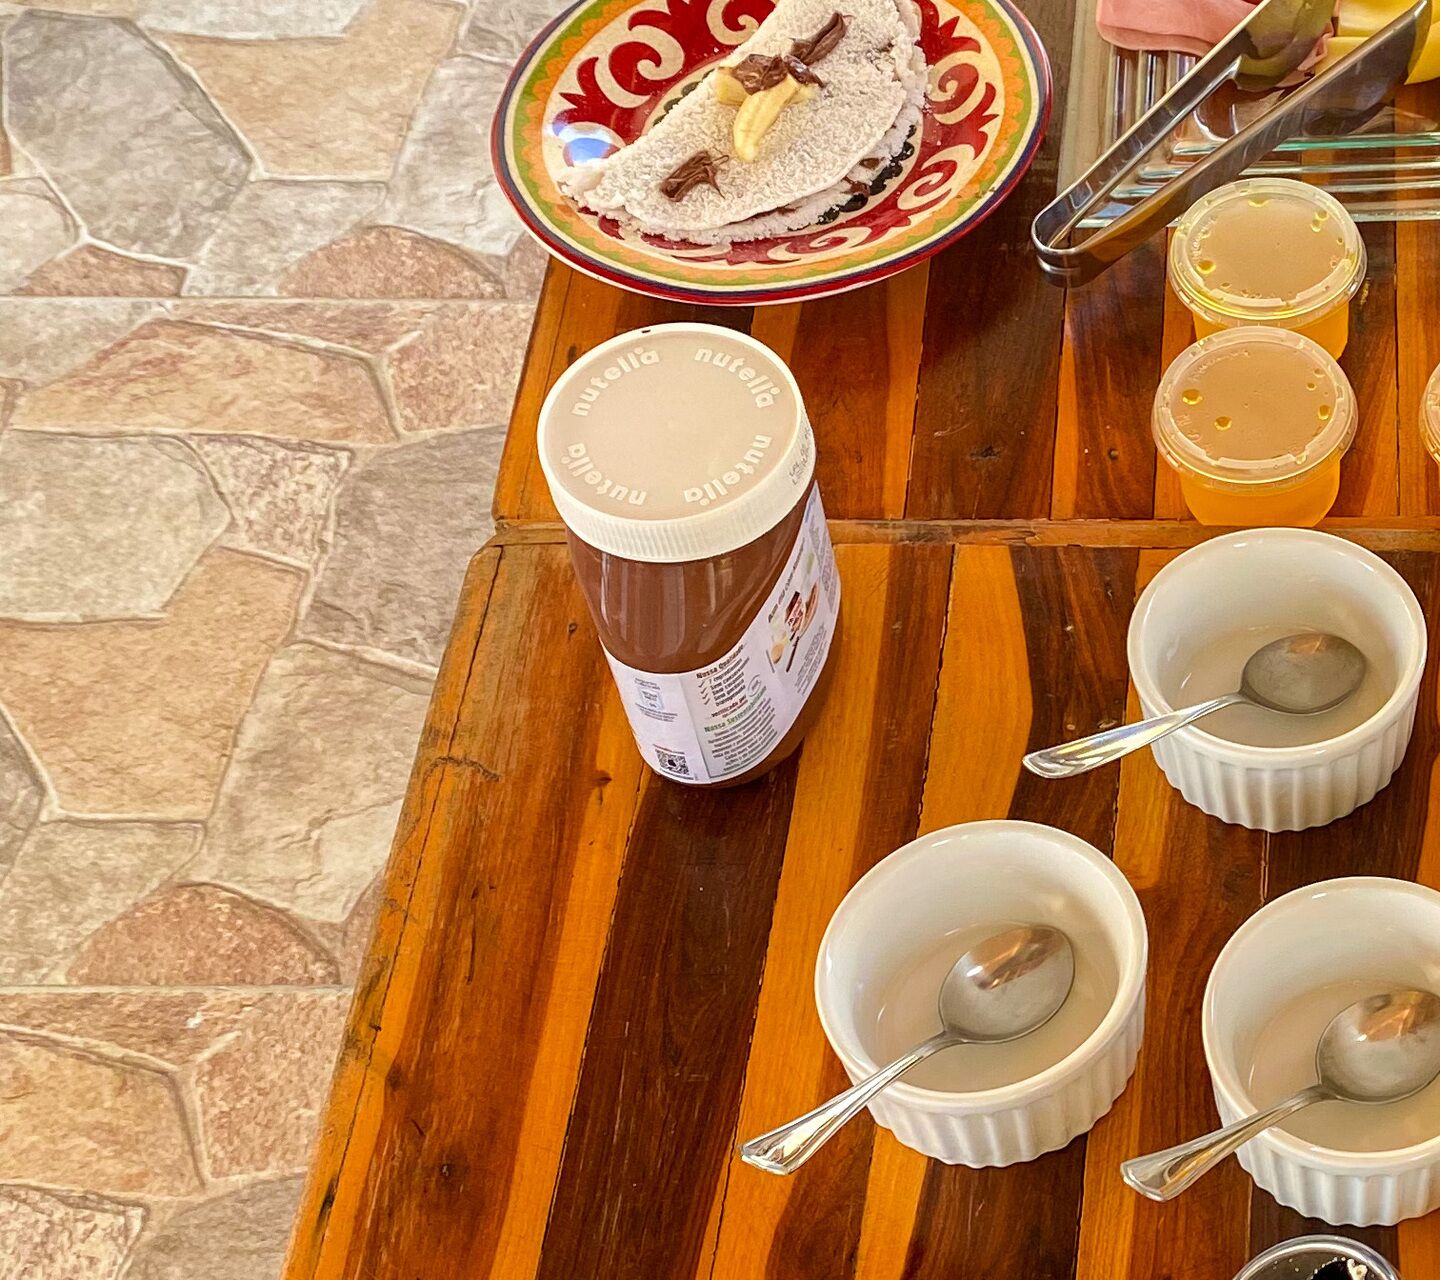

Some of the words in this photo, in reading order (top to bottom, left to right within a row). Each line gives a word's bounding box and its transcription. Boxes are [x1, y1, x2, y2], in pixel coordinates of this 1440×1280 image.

[571, 347, 661, 417] nutella
[694, 347, 781, 409] nutella
[561, 442, 648, 506] nutella
[683, 435, 772, 506] nutella
